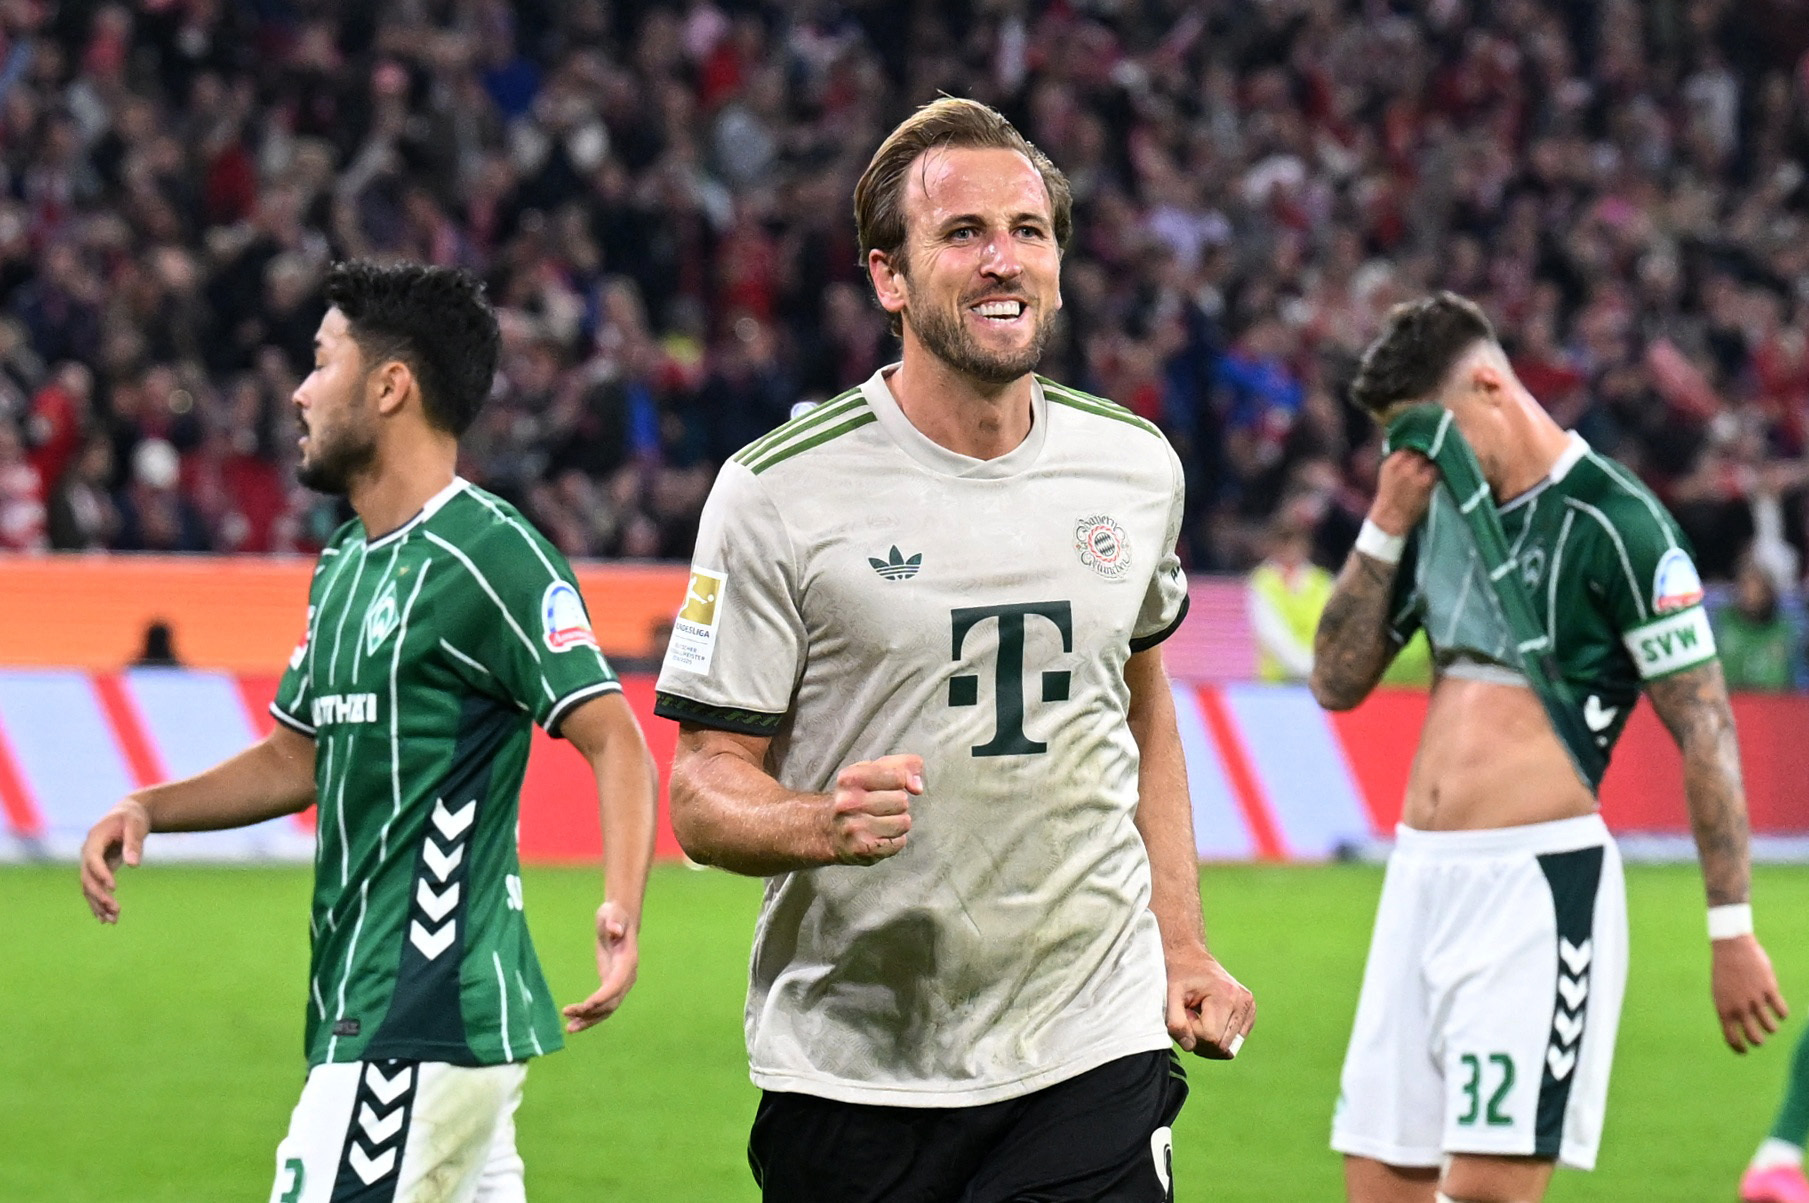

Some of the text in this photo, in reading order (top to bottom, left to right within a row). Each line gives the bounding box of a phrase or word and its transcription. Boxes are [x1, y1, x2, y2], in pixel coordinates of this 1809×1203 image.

[949, 600, 1073, 758] T
[1641, 623, 1698, 662] SVW
[1458, 1053, 1514, 1126] 32
